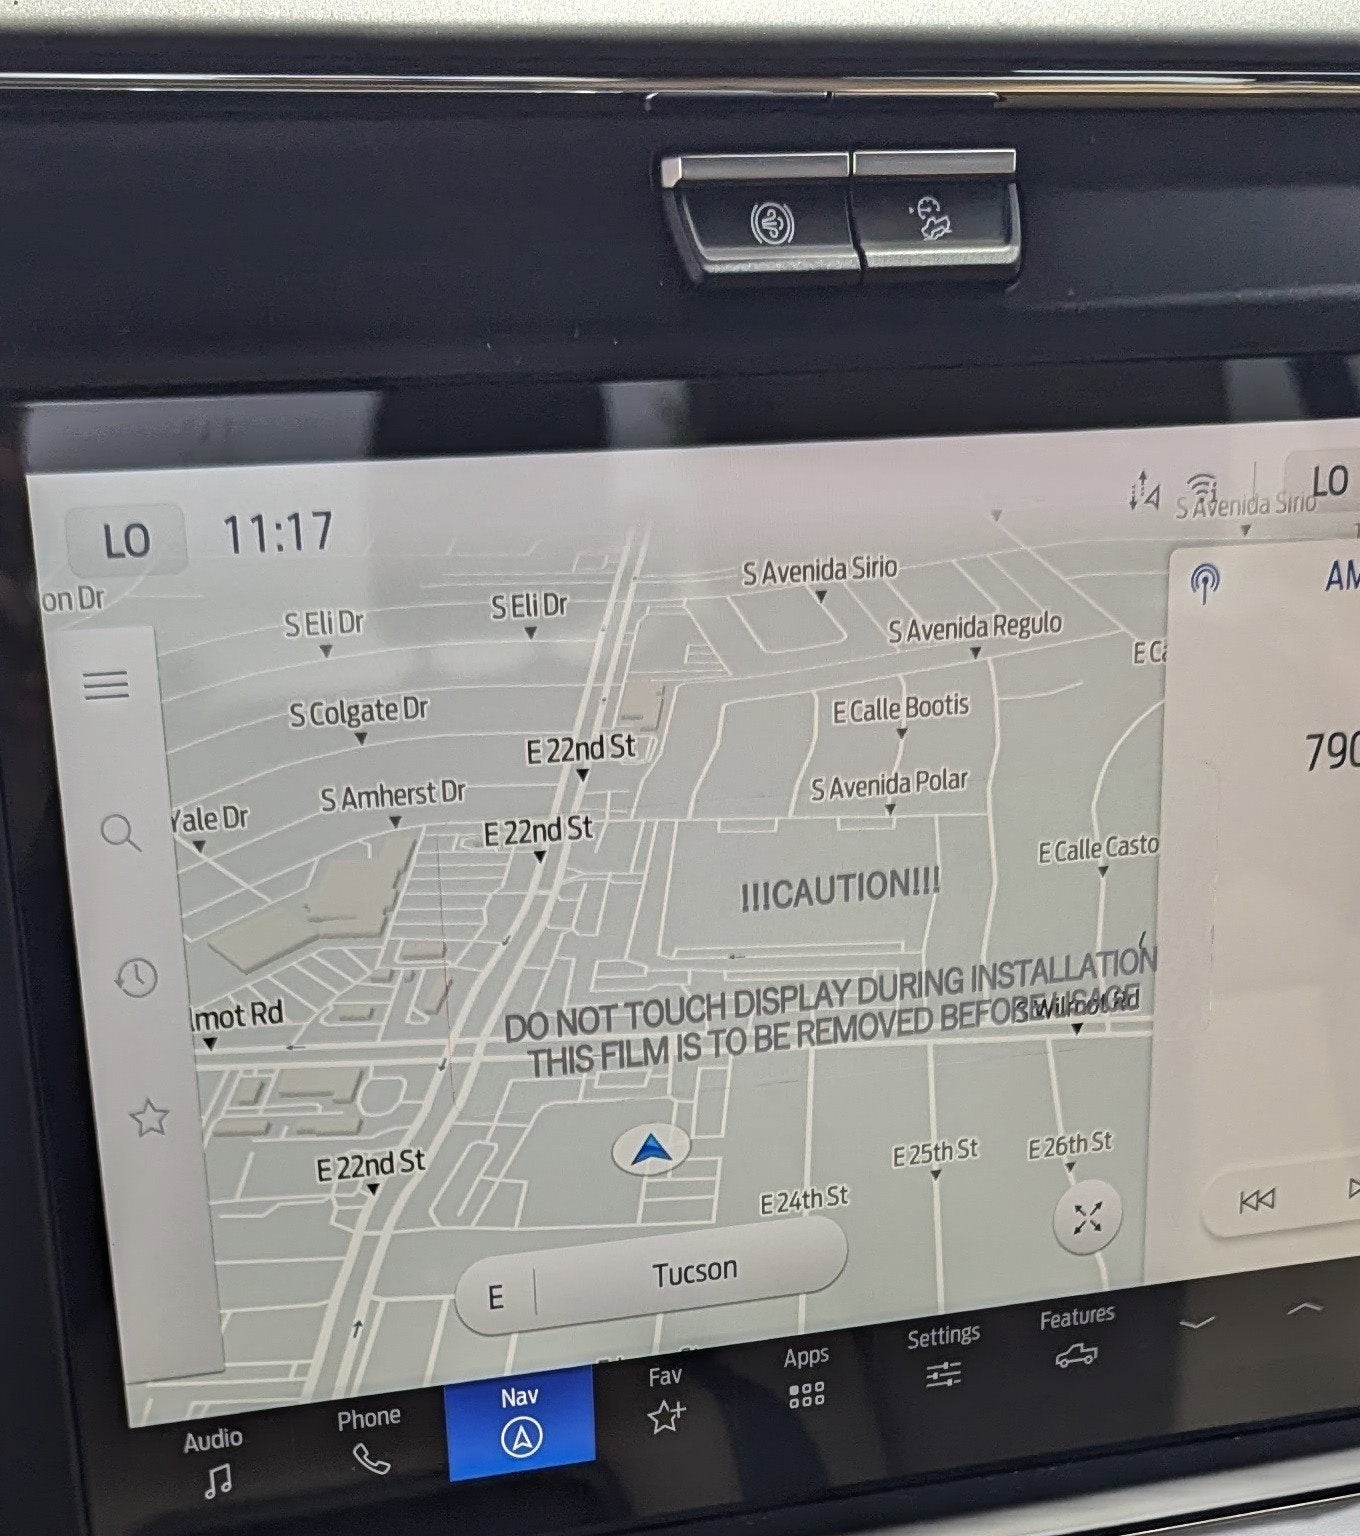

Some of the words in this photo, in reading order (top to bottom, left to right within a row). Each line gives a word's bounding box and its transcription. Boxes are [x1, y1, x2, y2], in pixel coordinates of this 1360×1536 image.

[1313, 465, 1349, 497] LO
[1192, 496, 1270, 518] Avenida
[1275, 494, 1317, 514] Sirio
[104, 522, 150, 559] LO
[225, 511, 334, 555] 11:17
[742, 562, 758, 585] S
[762, 556, 847, 583] Avenida
[851, 556, 898, 579] Sirio
[78, 585, 104, 609] Dr
[491, 595, 507, 619] S
[511, 594, 539, 617] Eli
[544, 592, 568, 615] Dr
[285, 614, 301, 638] S
[305, 613, 334, 636] Eli
[339, 611, 365, 634] Dr
[889, 620, 903, 643] S
[907, 616, 988, 642] Avenida
[993, 612, 1062, 639] Regulo
[1135, 642, 1146, 663] E
[290, 704, 306, 728] S
[309, 700, 399, 729] Colgate
[403, 696, 429, 720] Dr
[834, 701, 847, 724] E
[851, 696, 900, 722] Calle
[905, 694, 970, 718] Bootis
[527, 740, 542, 764] E
[547, 737, 605, 762] 22nd
[610, 734, 636, 758] St
[321, 789, 336, 813] S
[340, 784, 437, 811] Amherst
[441, 780, 466, 803] Dr
[812, 778, 825, 801] S
[829, 773, 911, 799] Avenida
[916, 769, 968, 793] Polar
[222, 806, 248, 828] Dr
[484, 822, 499, 846] E
[503, 818, 563, 843] 22nd
[567, 816, 593, 840] St
[1039, 842, 1053, 864] E
[1055, 838, 1101, 863] Calle
[1105, 835, 1159, 859] Casto
[505, 1013, 549, 1043] DO
[556, 1004, 618, 1038] NOT
[624, 994, 727, 1028] TOUCH
[734, 979, 852, 1019] DISPLAY
[857, 968, 964, 1003] DURING
[970, 946, 1158, 991] INSTALLATION
[251, 999, 284, 1025] Rd
[528, 1045, 594, 1078] THIS
[601, 1035, 669, 1070] FILM
[677, 1032, 701, 1062] IS
[708, 1026, 746, 1057] TO
[754, 1022, 790, 1051] BE
[797, 1008, 933, 1048] REMOVED
[940, 993, 1046, 1032] BEFORE
[893, 1148, 904, 1167] E
[908, 1142, 953, 1164] 25th
[957, 1140, 978, 1159] St
[1029, 1139, 1040, 1159] E
[1043, 1135, 1088, 1157] 26th
[1091, 1131, 1112, 1151] St
[318, 1159, 331, 1181] E
[336, 1153, 394, 1180] 22nd
[400, 1150, 425, 1173] St
[761, 1195, 772, 1214] E
[776, 1189, 824, 1213] 24th
[827, 1186, 849, 1206] St
[489, 1285, 503, 1310] E
[652, 1259, 737, 1288] Tucson
[1040, 1304, 1115, 1330] Features
[907, 1323, 981, 1350] Settings
[784, 1347, 829, 1368] Apps
[649, 1366, 682, 1386] Fav
[501, 1388, 538, 1408] Nav
[338, 1407, 401, 1431] Phone
[183, 1429, 243, 1454] Audio
